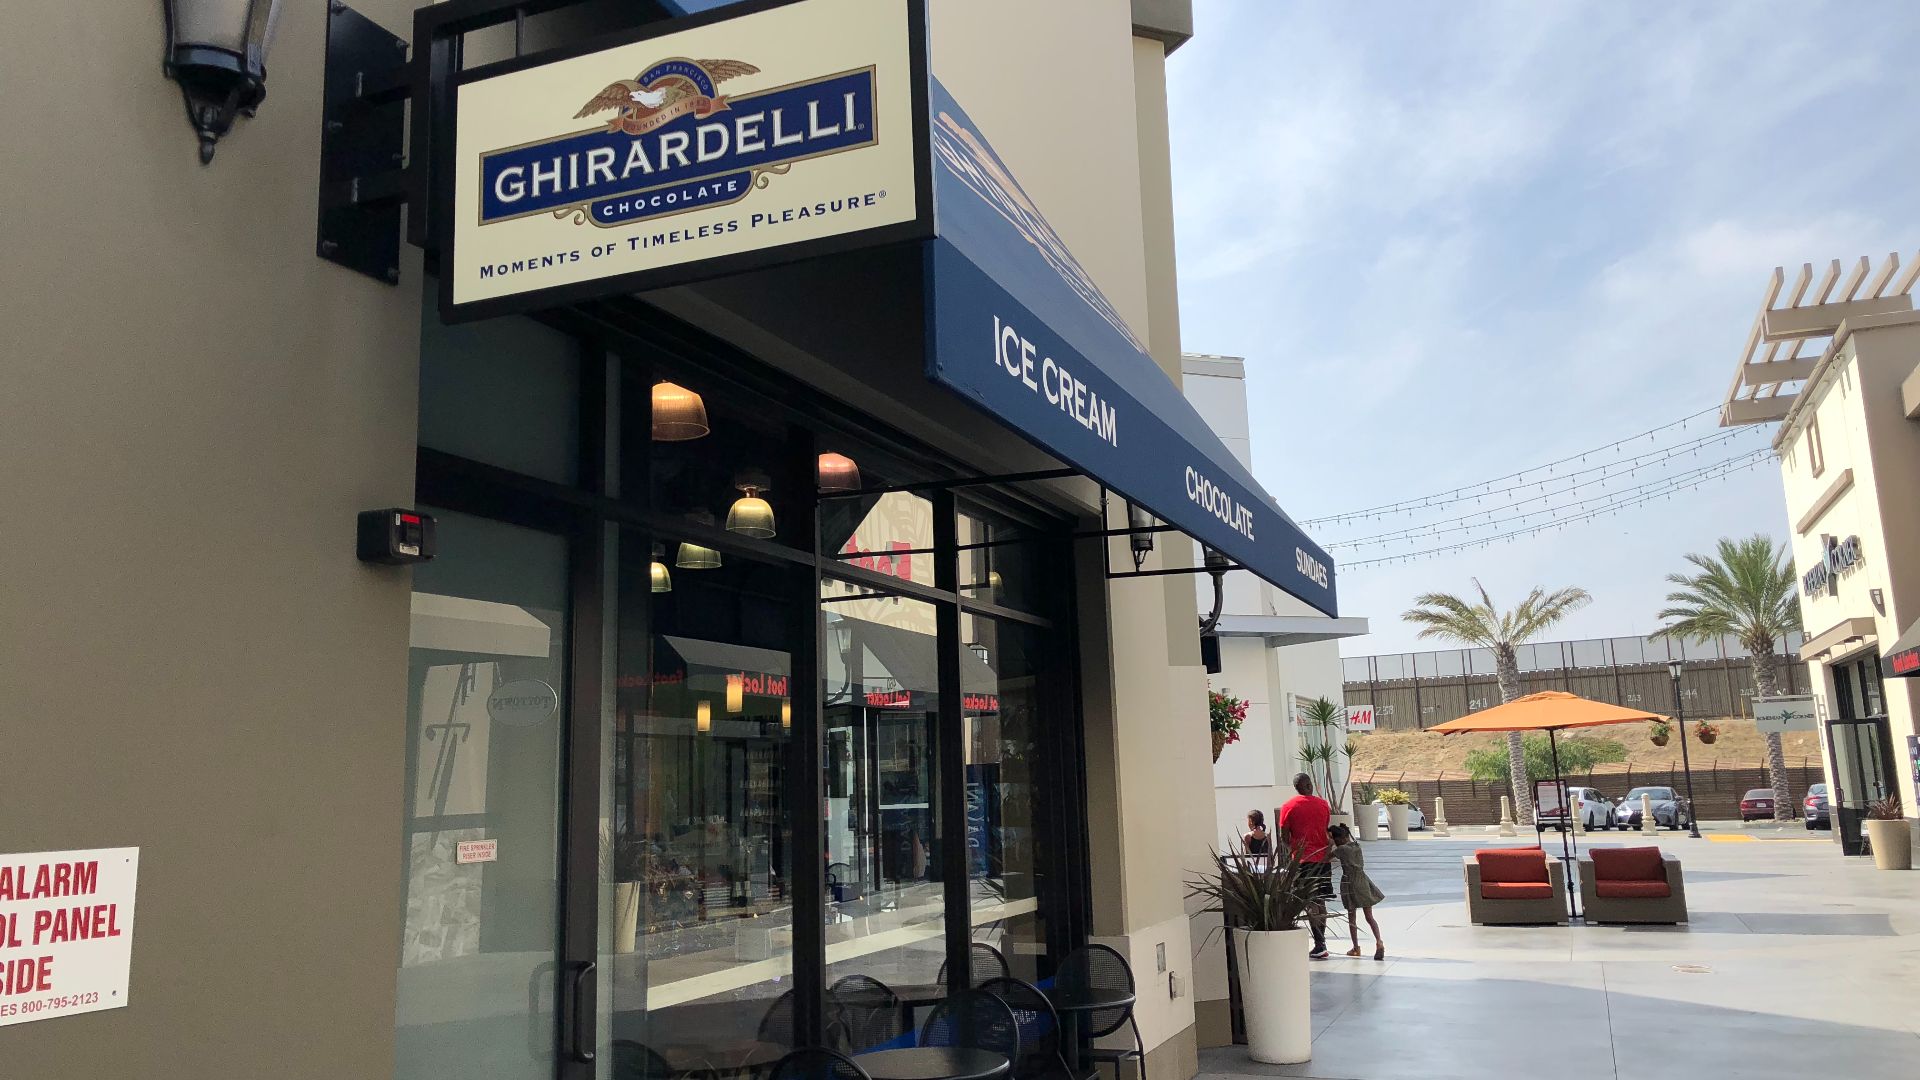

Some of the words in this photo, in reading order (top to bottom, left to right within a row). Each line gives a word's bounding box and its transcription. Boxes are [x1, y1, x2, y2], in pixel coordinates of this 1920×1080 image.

[643, 69, 661, 84] SAN
[666, 64, 708, 90] FRANCISCO
[494, 91, 858, 204] GHIRARDELLI
[603, 180, 738, 217] CHOCOLATE
[480, 250, 580, 279] MOMENTS
[591, 243, 617, 258] OF
[627, 220, 739, 251] TIMELESS
[993, 314, 1038, 393] ICE
[1042, 357, 1118, 448] CREAM
[1185, 465, 1256, 542] CHOCOLATE
[1295, 547, 1328, 589] SUNDAES
[1350, 711, 1371, 725] H&M
[0, 861, 98, 900] ALARM
[32, 903, 121, 945] PANEL
[21, 991, 99, 1014] 800-795-2123
